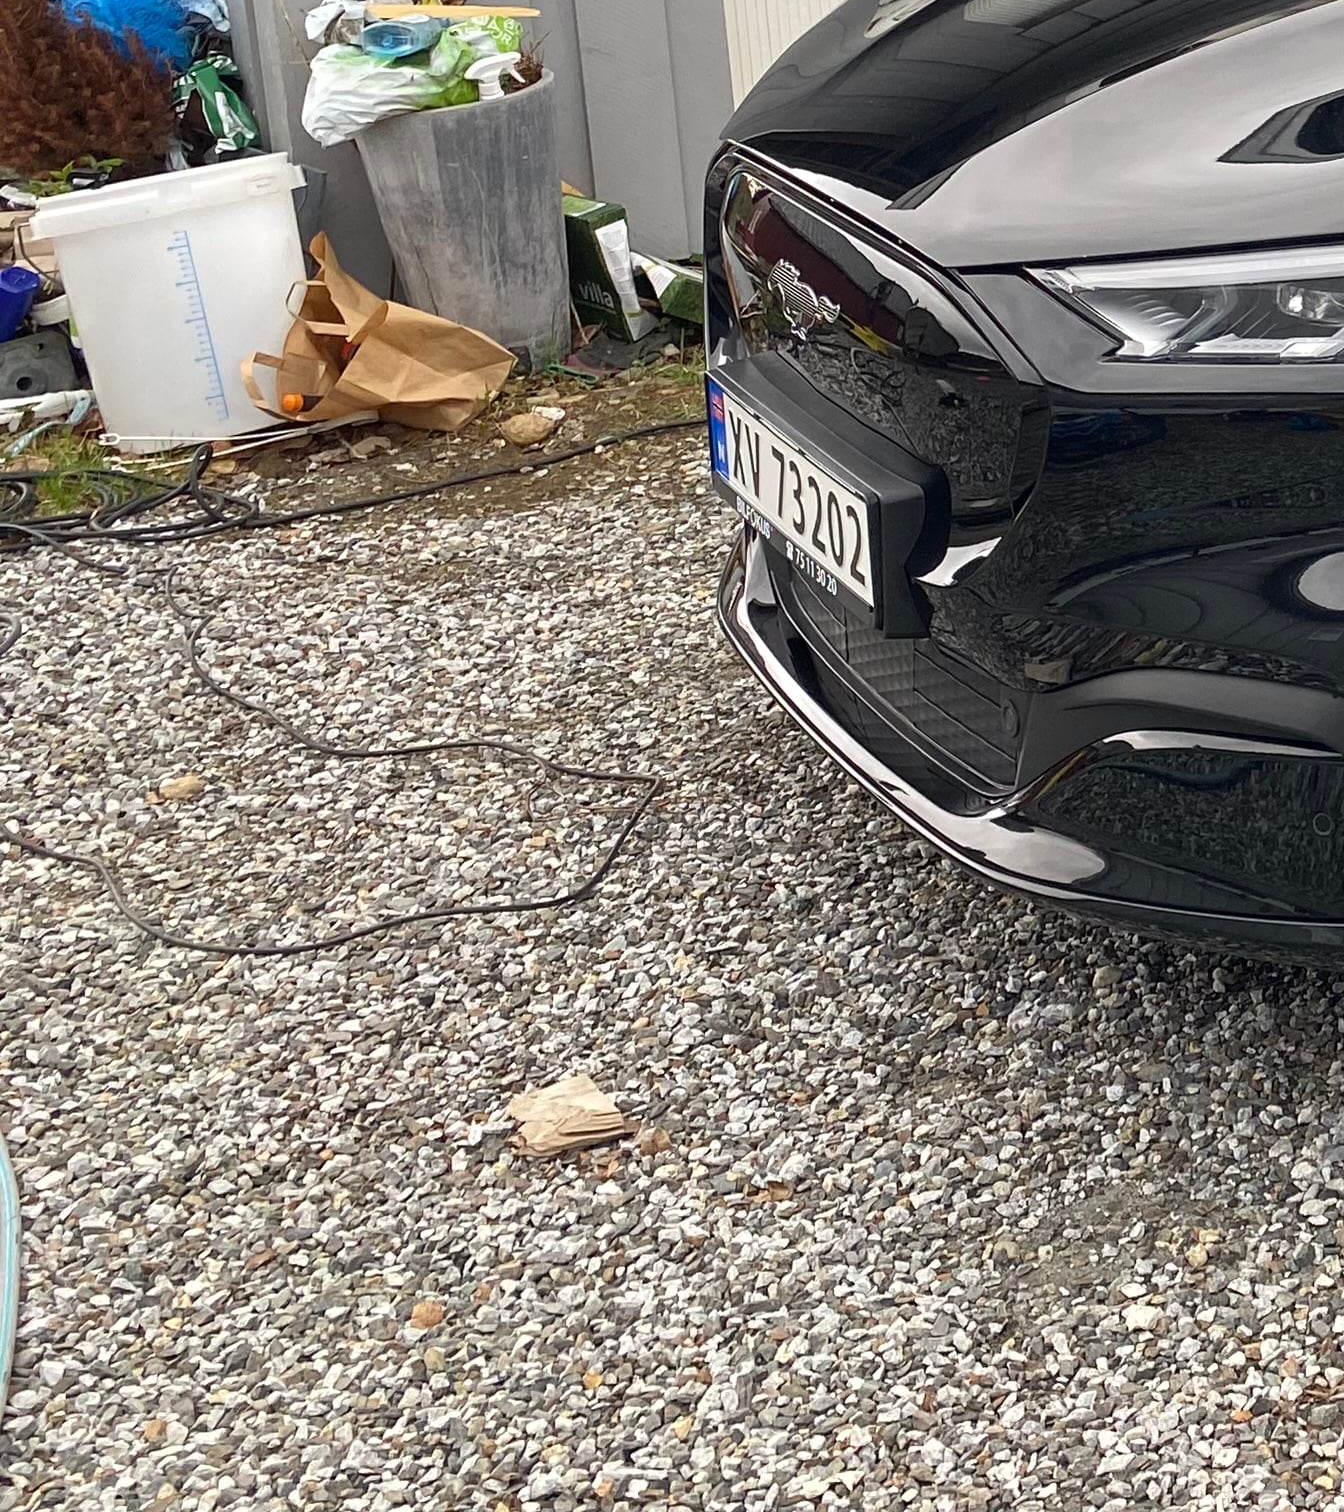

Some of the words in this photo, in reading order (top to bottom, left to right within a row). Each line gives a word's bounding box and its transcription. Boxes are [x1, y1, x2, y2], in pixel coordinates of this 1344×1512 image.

[578, 281, 615, 309] villa
[728, 409, 760, 498] XV
[771, 444, 866, 587] 73202
